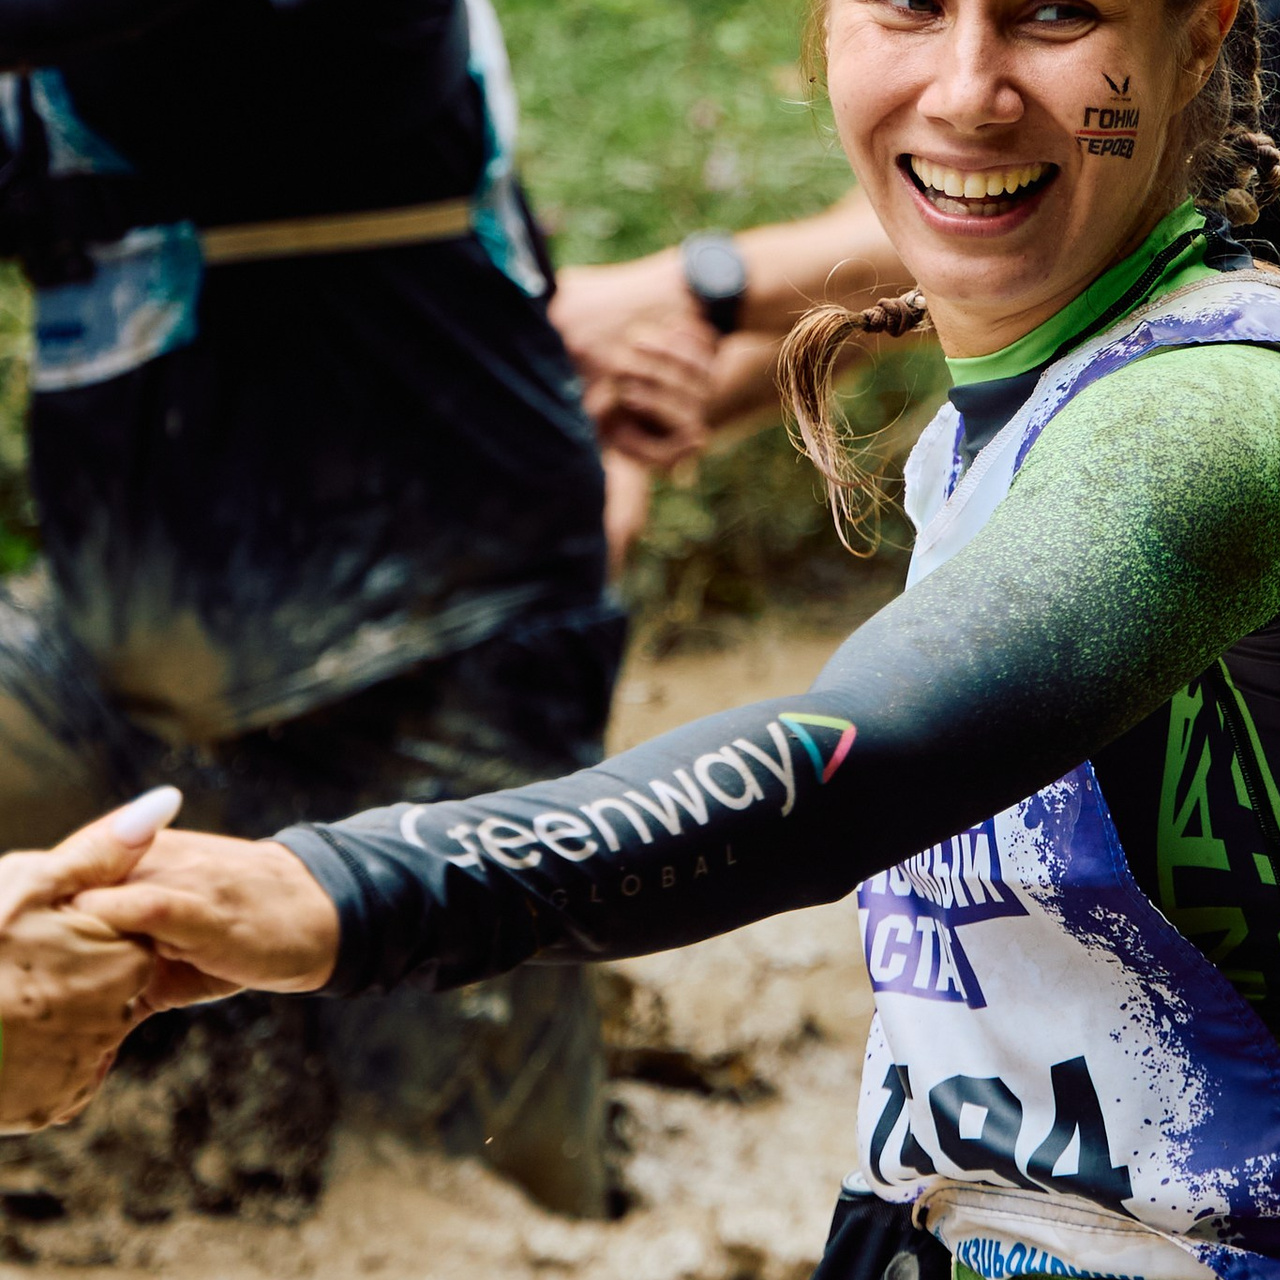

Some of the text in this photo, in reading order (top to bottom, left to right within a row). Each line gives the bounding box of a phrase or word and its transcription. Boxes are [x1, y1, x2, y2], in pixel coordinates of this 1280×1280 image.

[1083, 107, 1140, 129] ГОНКА
[1075, 136, 1135, 160] ГЕРОЕВ
[551, 844, 738, 912] GLOBAL
